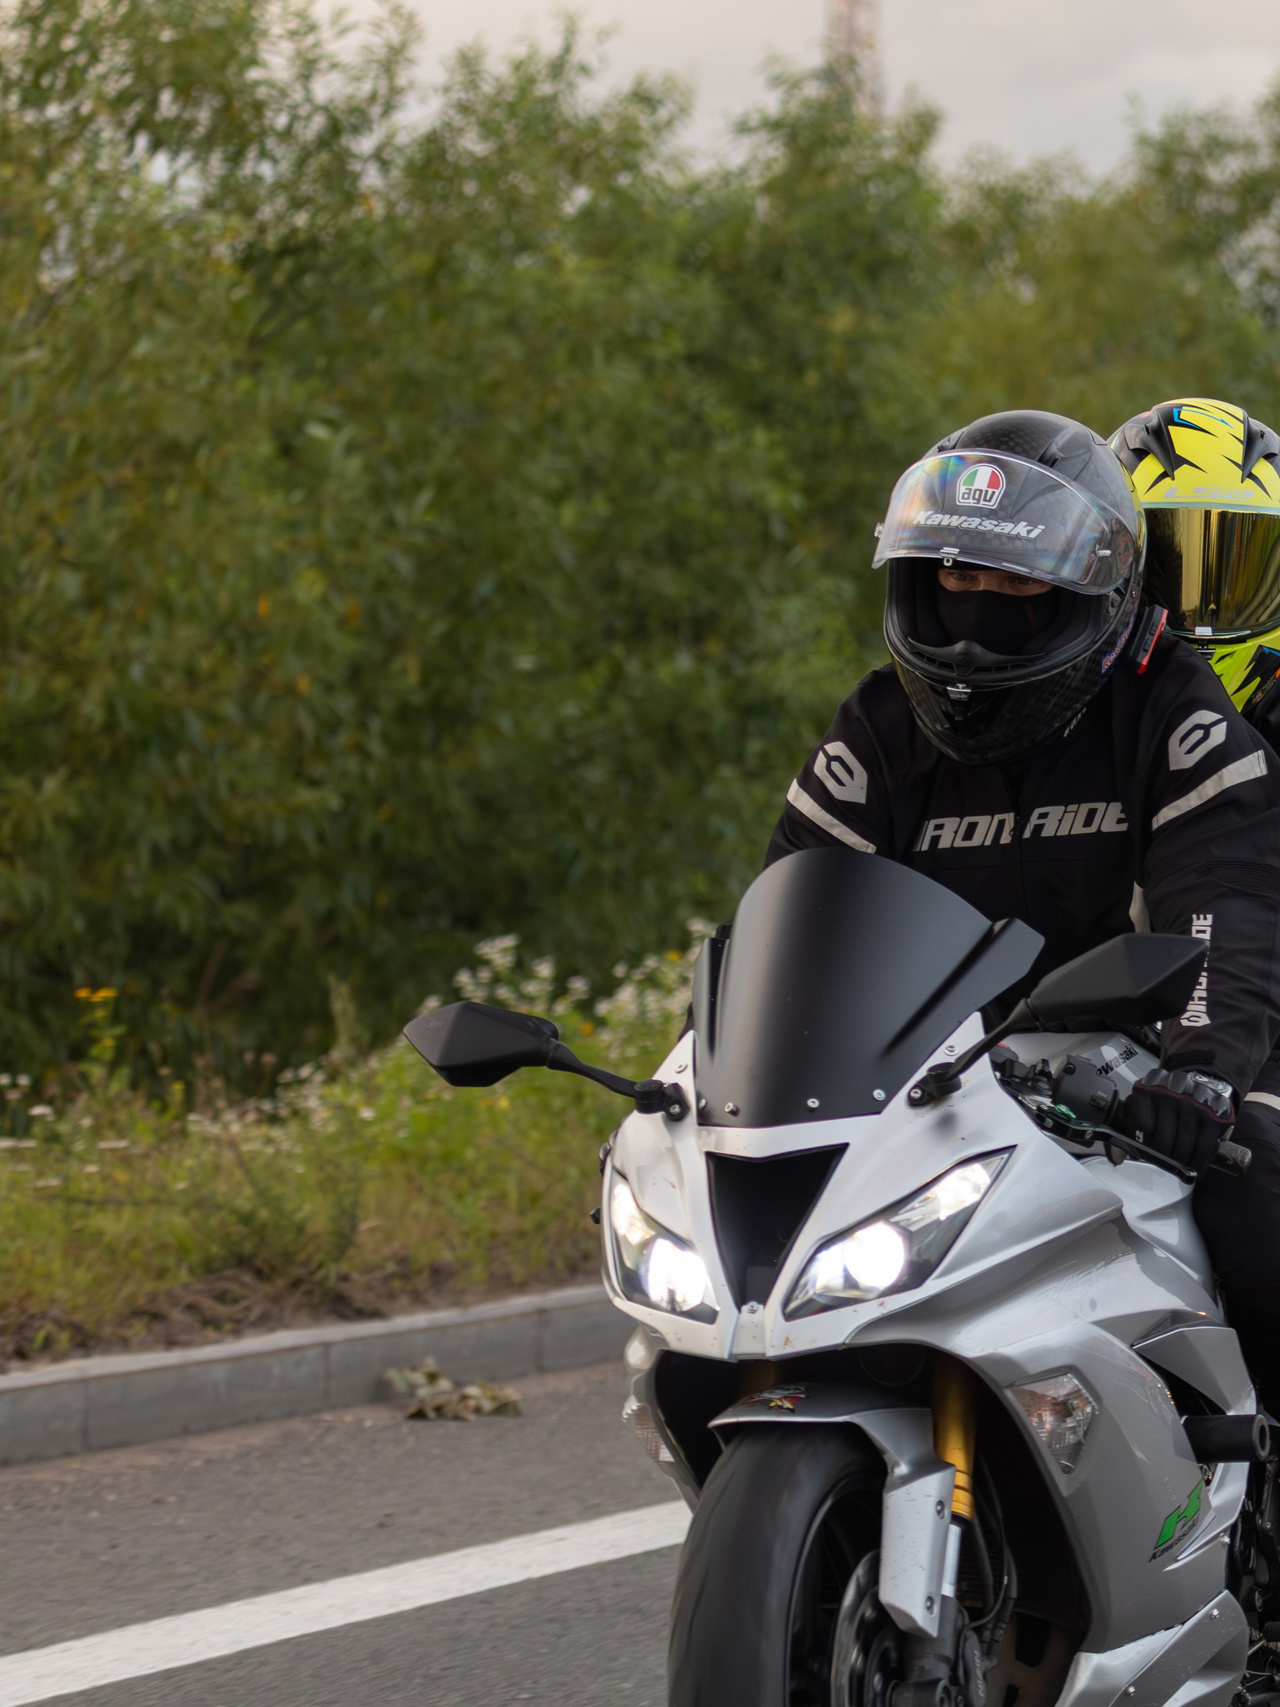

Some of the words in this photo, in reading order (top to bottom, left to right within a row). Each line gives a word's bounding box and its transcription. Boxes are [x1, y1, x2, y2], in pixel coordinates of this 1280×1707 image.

[1163, 486, 1255, 503] LS2
[912, 509, 1046, 540] Kawasaki
[1096, 1043, 1139, 1076] awasaki
